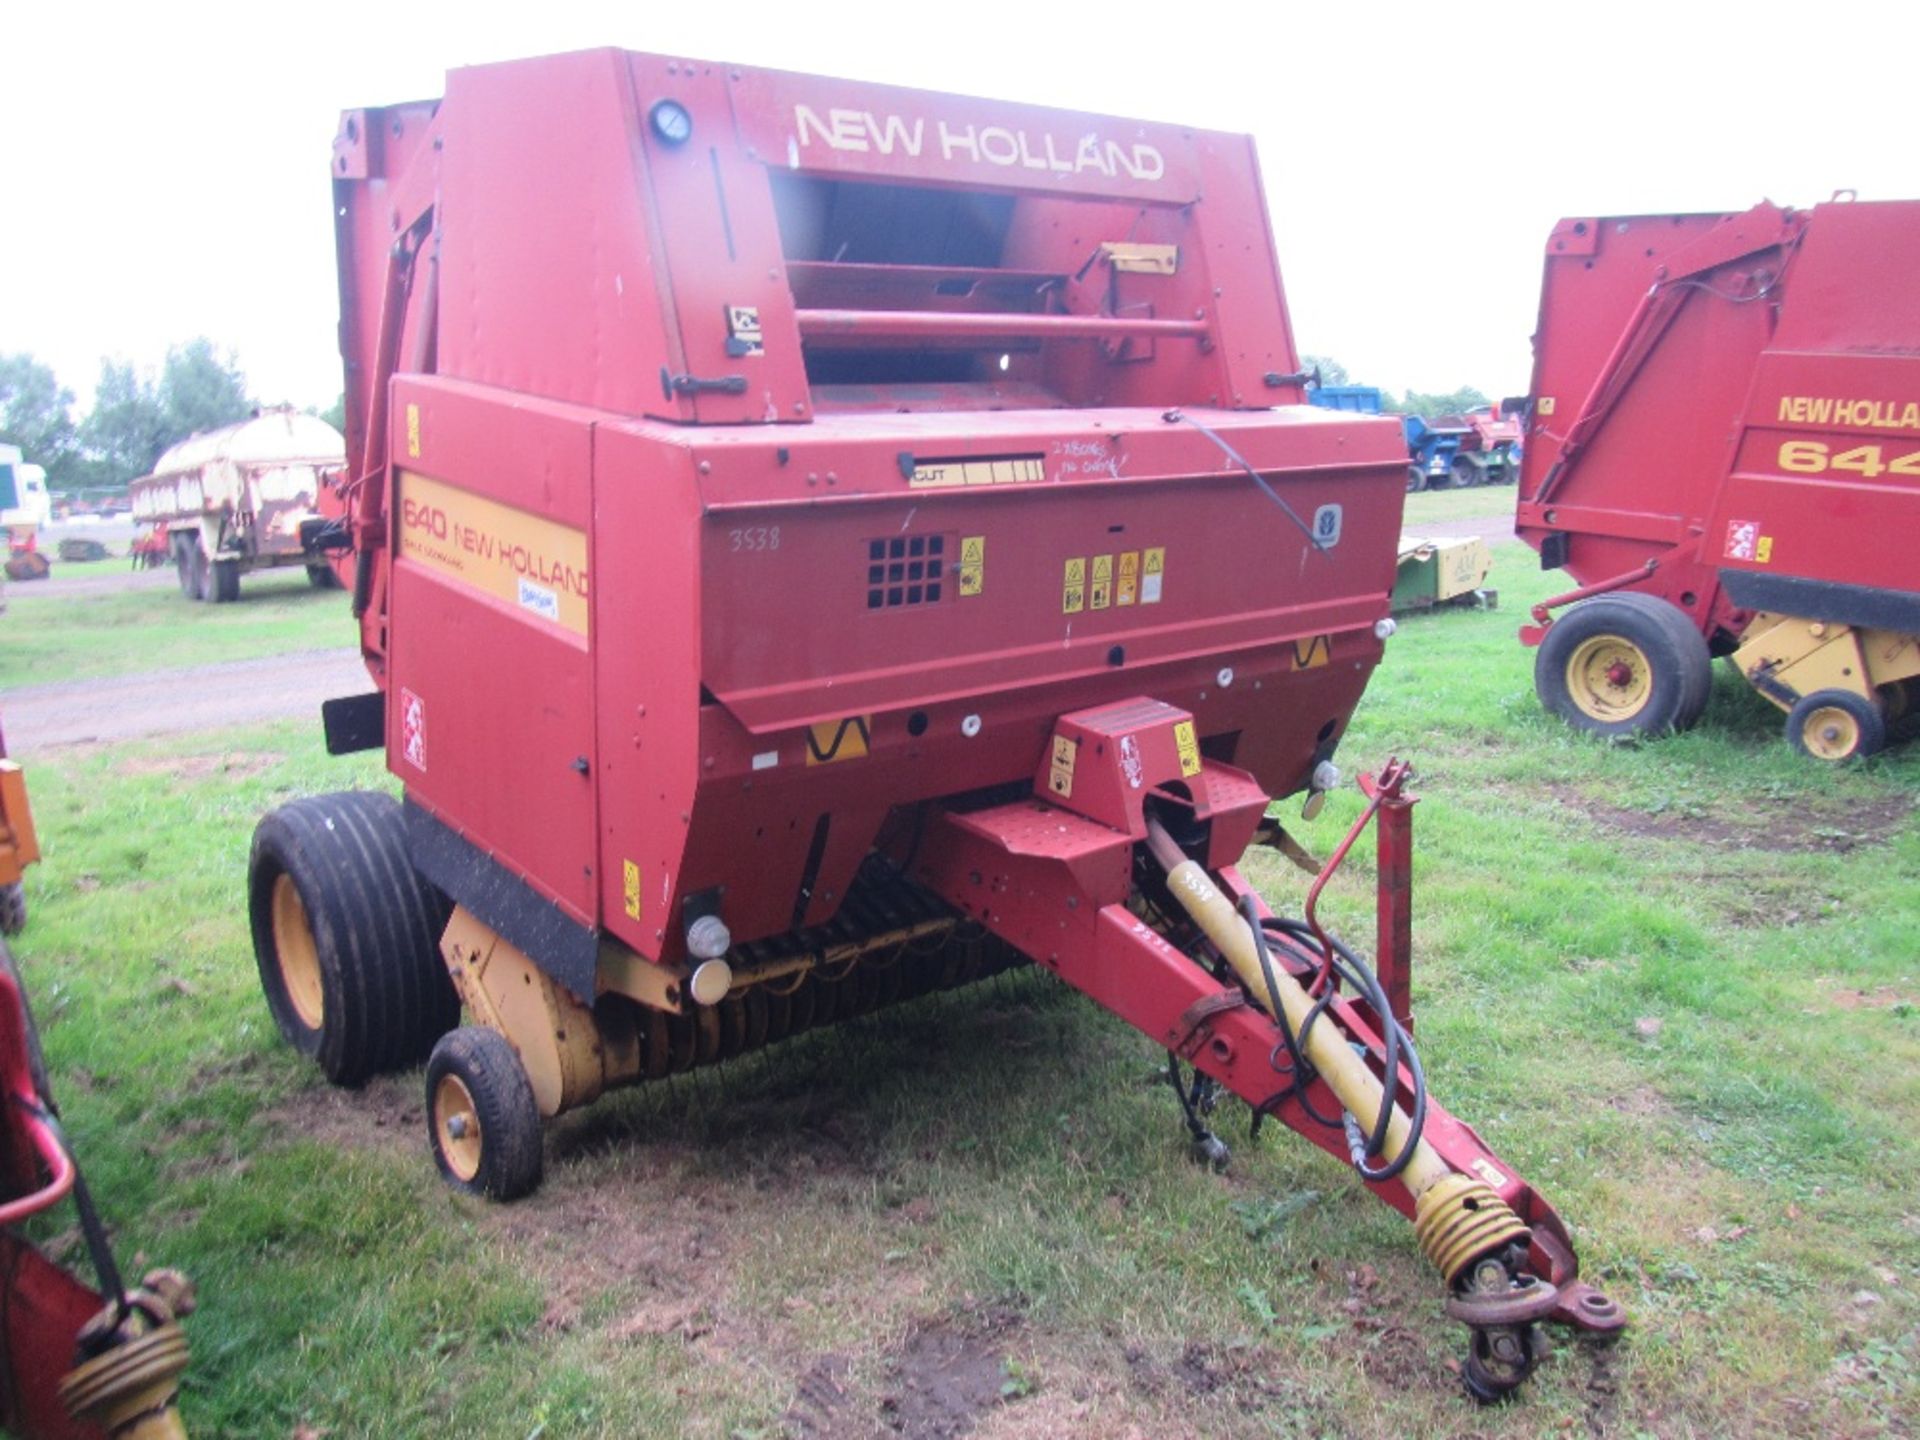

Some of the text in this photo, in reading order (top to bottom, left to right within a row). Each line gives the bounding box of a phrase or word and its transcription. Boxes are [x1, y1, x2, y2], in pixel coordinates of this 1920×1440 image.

[795, 105, 1165, 182] NEW HOLLAND
[1778, 396, 1833, 424] NEW
[404, 498, 447, 540] 640
[454, 523, 495, 560] NEW
[499, 539, 588, 598] HOLLAND
